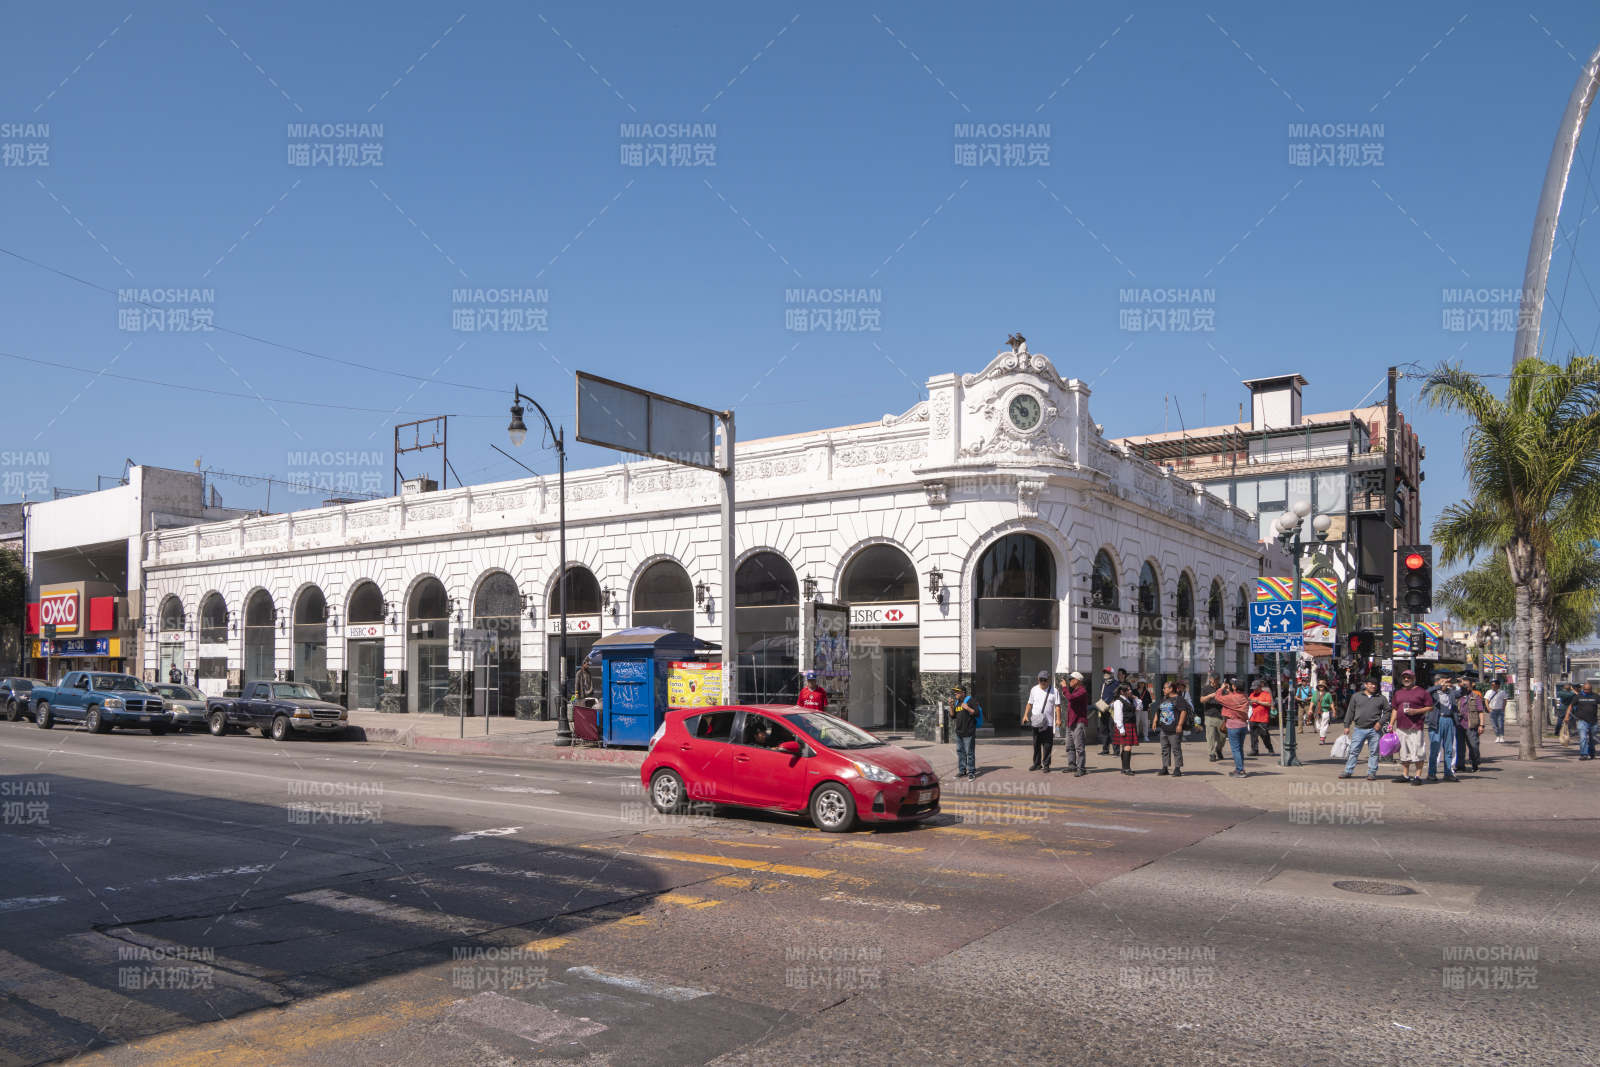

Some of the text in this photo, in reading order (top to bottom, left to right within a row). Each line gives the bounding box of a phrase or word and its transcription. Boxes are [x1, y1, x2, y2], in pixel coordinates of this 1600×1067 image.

[42, 596, 75, 624] OXXO
[850, 609, 882, 622] HSBC
[1254, 603, 1297, 616] USA
[1097, 611, 1113, 625] HSBC
[553, 621, 576, 632] HBC
